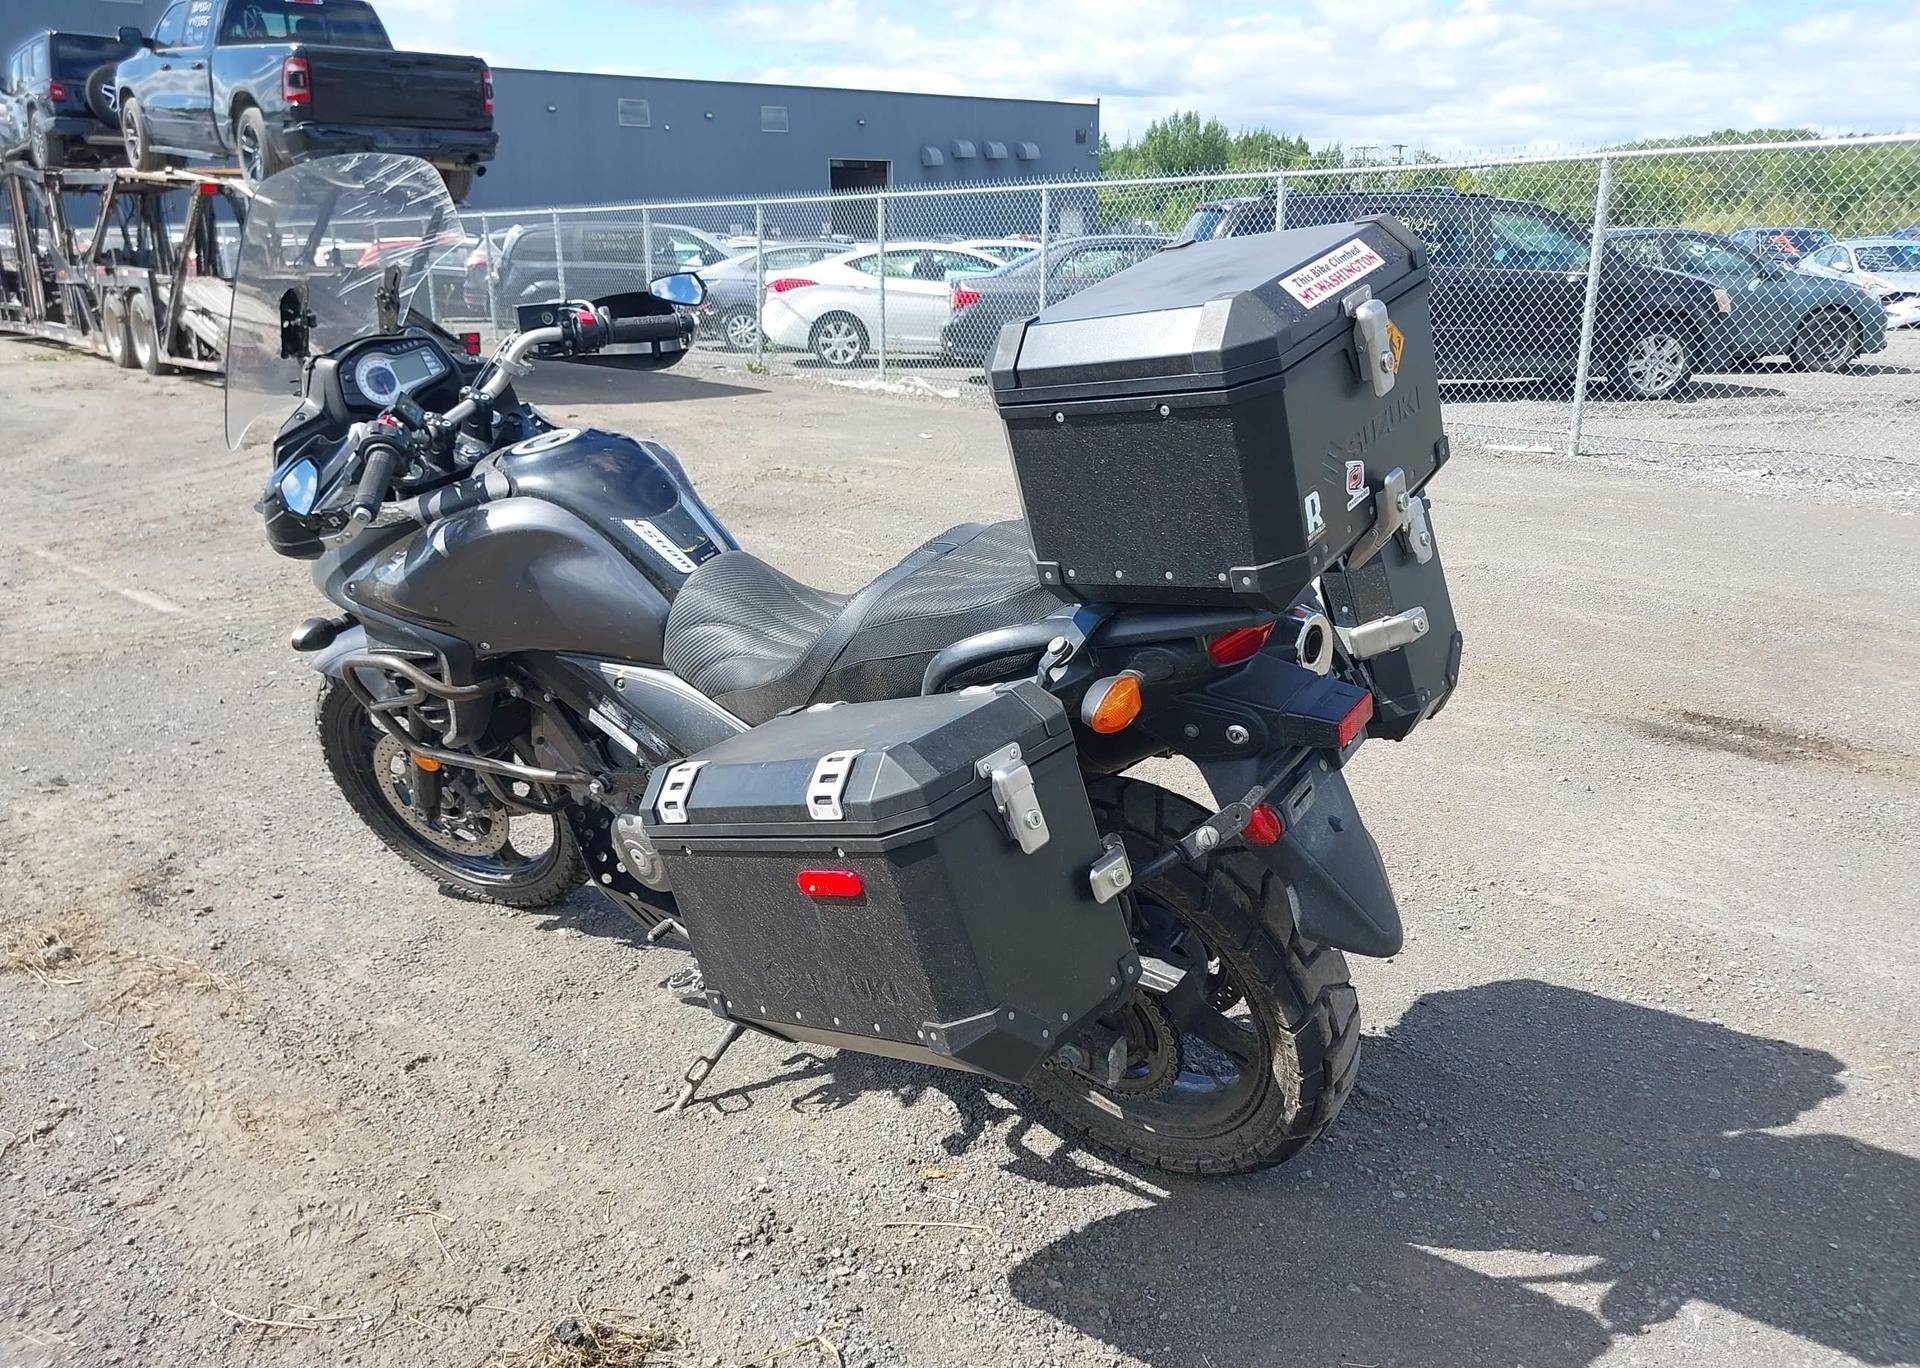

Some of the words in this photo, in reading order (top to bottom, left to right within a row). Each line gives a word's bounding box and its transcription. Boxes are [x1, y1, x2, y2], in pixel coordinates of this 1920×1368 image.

[1291, 273, 1314, 287] This
[1309, 264, 1332, 278] Bike
[1328, 245, 1361, 268] Climbed
[1298, 286, 1321, 303] MT.
[1314, 252, 1379, 293] WASHINGTON
[1350, 386, 1421, 452] SUZUKI
[1304, 490, 1324, 534] R
